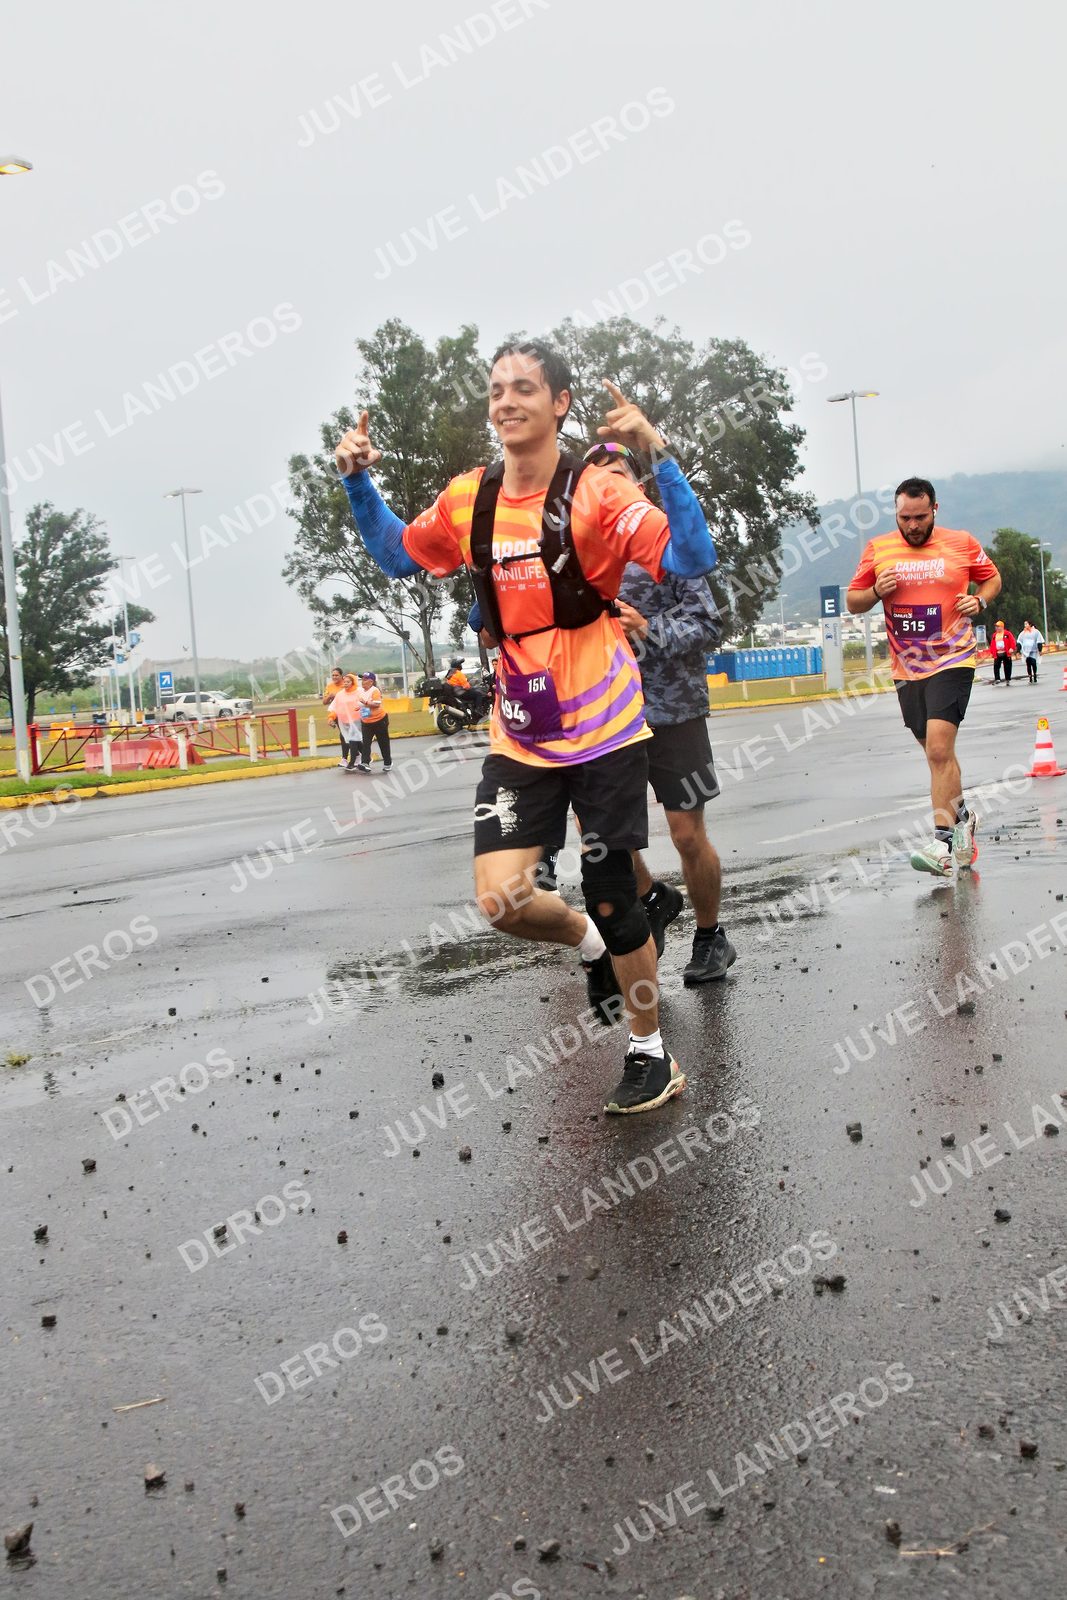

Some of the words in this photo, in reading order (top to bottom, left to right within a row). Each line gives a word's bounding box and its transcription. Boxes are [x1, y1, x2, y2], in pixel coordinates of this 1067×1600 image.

[895, 558, 945, 572] CARRERA
[825, 599, 835, 614] E
[927, 607, 938, 616] 15K
[902, 620, 926, 632] 515
[528, 676, 546, 693] 15K
